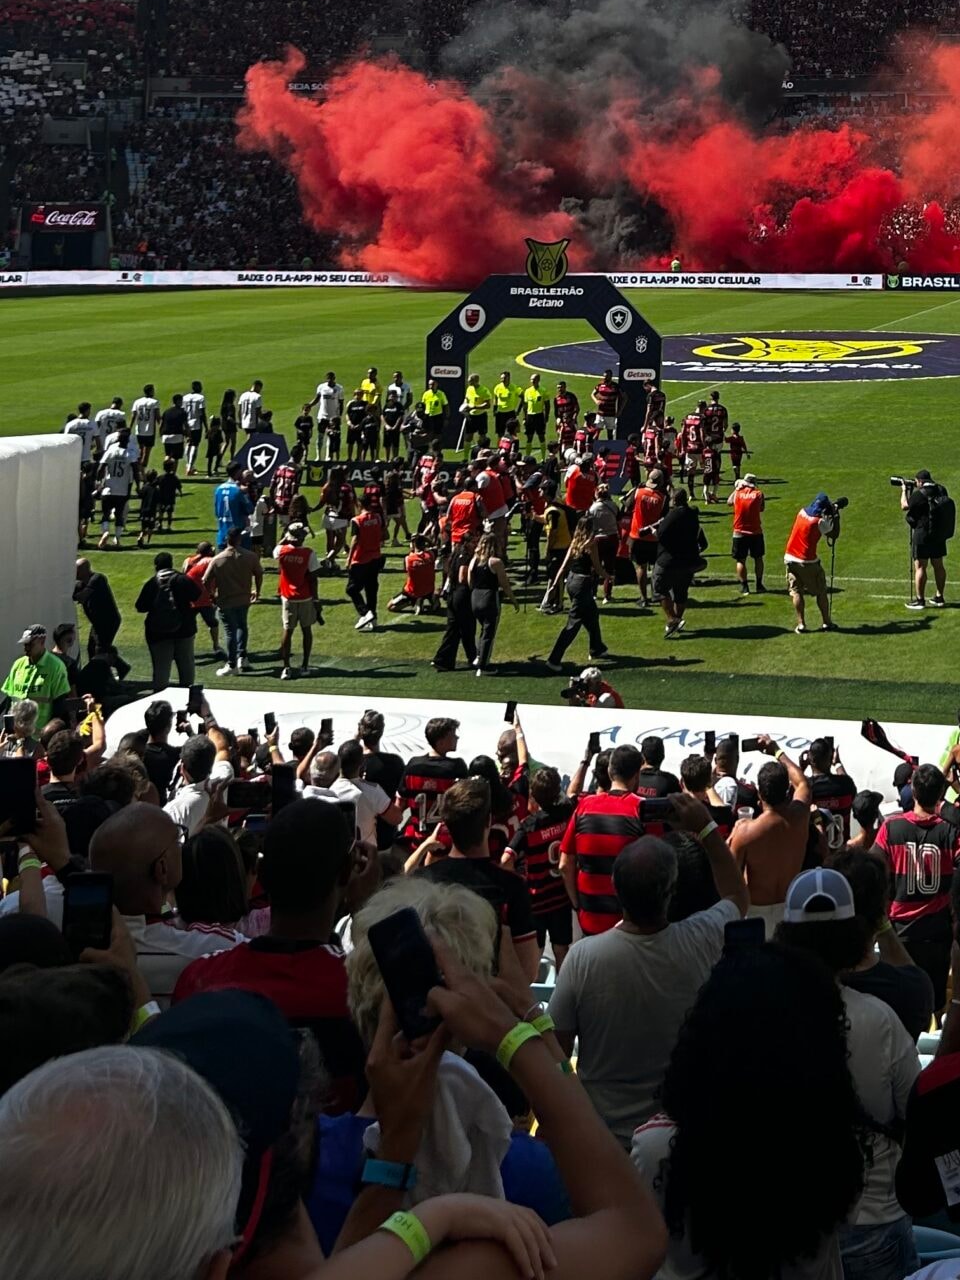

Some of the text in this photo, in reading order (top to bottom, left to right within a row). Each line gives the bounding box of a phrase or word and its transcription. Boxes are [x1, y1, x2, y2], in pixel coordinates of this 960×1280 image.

[237, 274, 389, 283] BAIXE O FLA-APP NO SEU CELULAR
[630, 276, 638, 284] O
[639, 276, 680, 284] FLA-APP
[681, 276, 696, 284] NO
[697, 276, 716, 285] SEU
[718, 276, 761, 285] CELULAR
[510, 286, 584, 296] BRASILEIRÃO
[528, 298, 564, 308] Betano
[113, 461, 124, 477] 15
[284, 555, 303, 564] FOTO
[905, 841, 941, 895] 10
